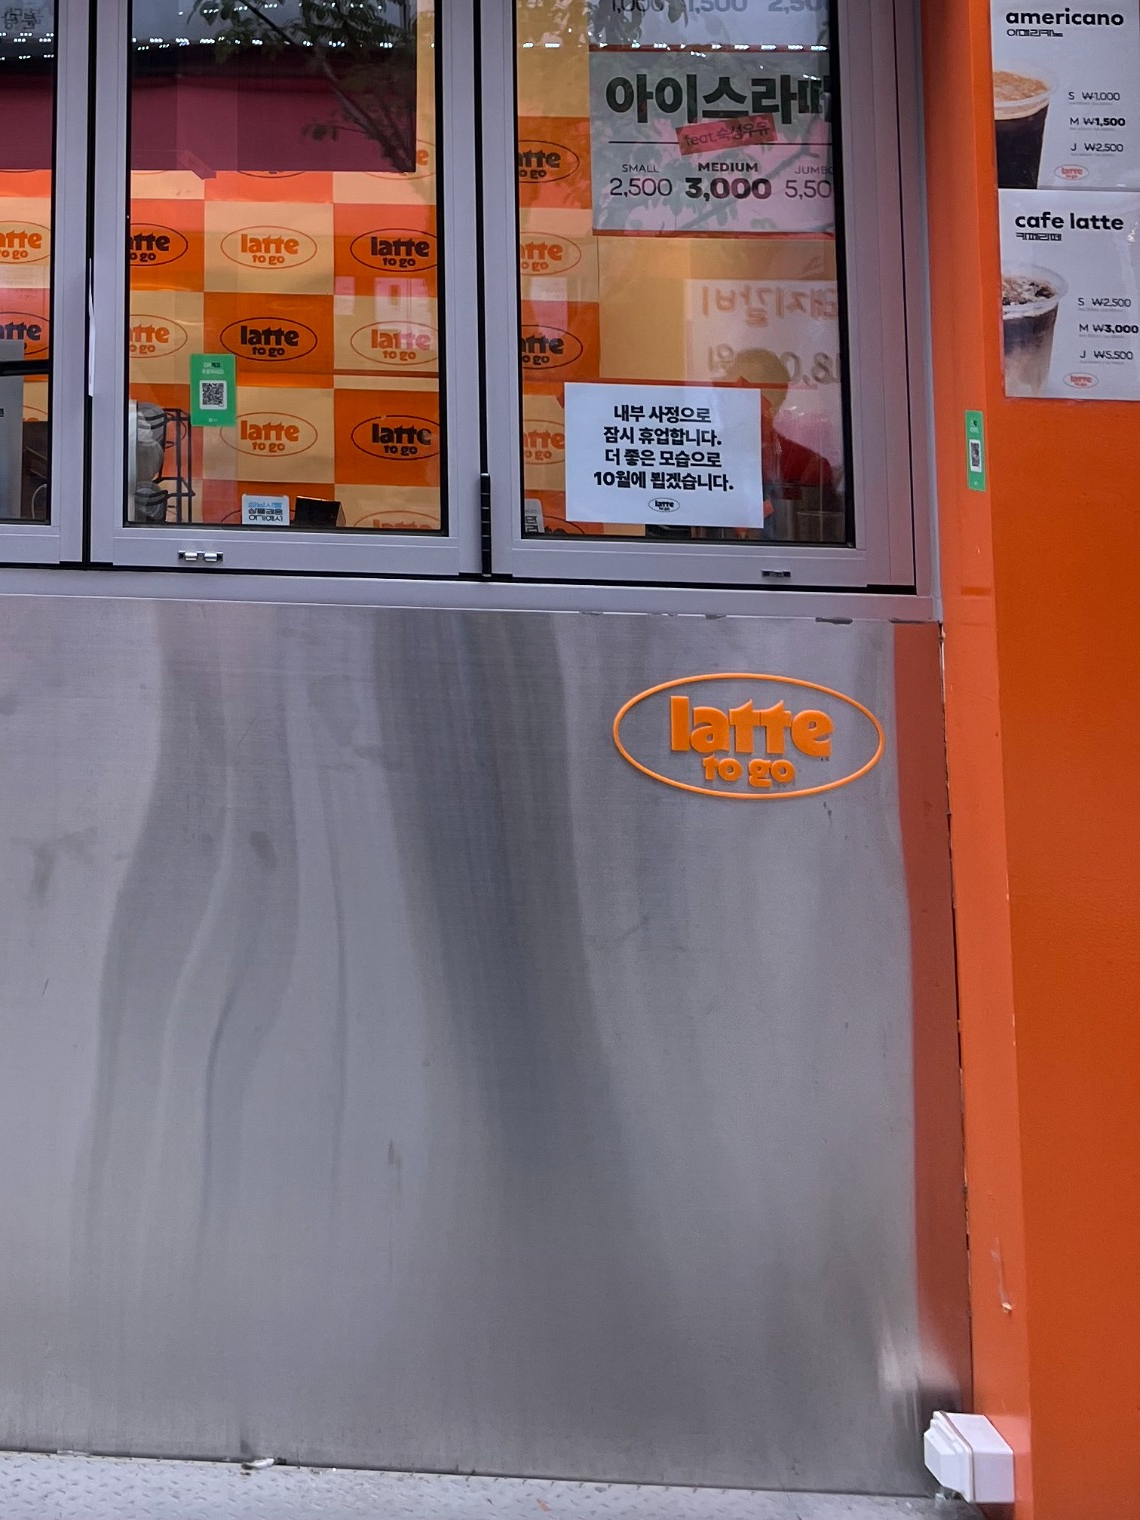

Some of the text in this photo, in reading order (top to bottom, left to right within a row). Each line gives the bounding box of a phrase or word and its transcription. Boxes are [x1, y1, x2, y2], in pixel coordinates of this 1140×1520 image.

[1006, 8, 1124, 26] americano
[1068, 92, 1075, 100] S
[1069, 117, 1079, 126] M
[1070, 143, 1077, 152] J
[622, 163, 659, 174] SMALL
[698, 161, 759, 173] MEDIUM
[529, 170, 547, 179] go
[610, 177, 673, 198] 2,500
[685, 177, 772, 200] 3,000
[1015, 211, 1124, 230] cafe latte
[241, 234, 300, 255] latte
[370, 236, 430, 257] latte
[12, 250, 29, 260] go
[139, 253, 157, 262] go
[252, 253, 286, 265] to go
[383, 256, 416, 268] to go
[531, 262, 549, 272] go
[1078, 298, 1085, 307] S
[1079, 323, 1089, 333] M
[240, 325, 300, 346] latte
[371, 329, 432, 350] latte
[139, 345, 156, 355] go
[252, 345, 286, 357] to go
[383, 349, 417, 361] to go
[1079, 350, 1086, 359] J
[532, 355, 550, 365] go
[614, 404, 712, 424] 내부 사정으로
[240, 419, 300, 441] latte
[371, 423, 432, 445] latte
[603, 426, 722, 447] 잠시 휴업합니다.
[252, 441, 286, 453] to go
[384, 443, 419, 455] to go
[534, 450, 552, 460] go
[605, 448, 722, 468] 더 좋은 모습으로
[593, 471, 646, 489] 10월에
[670, 695, 834, 757] latte
[702, 753, 796, 788] to go
